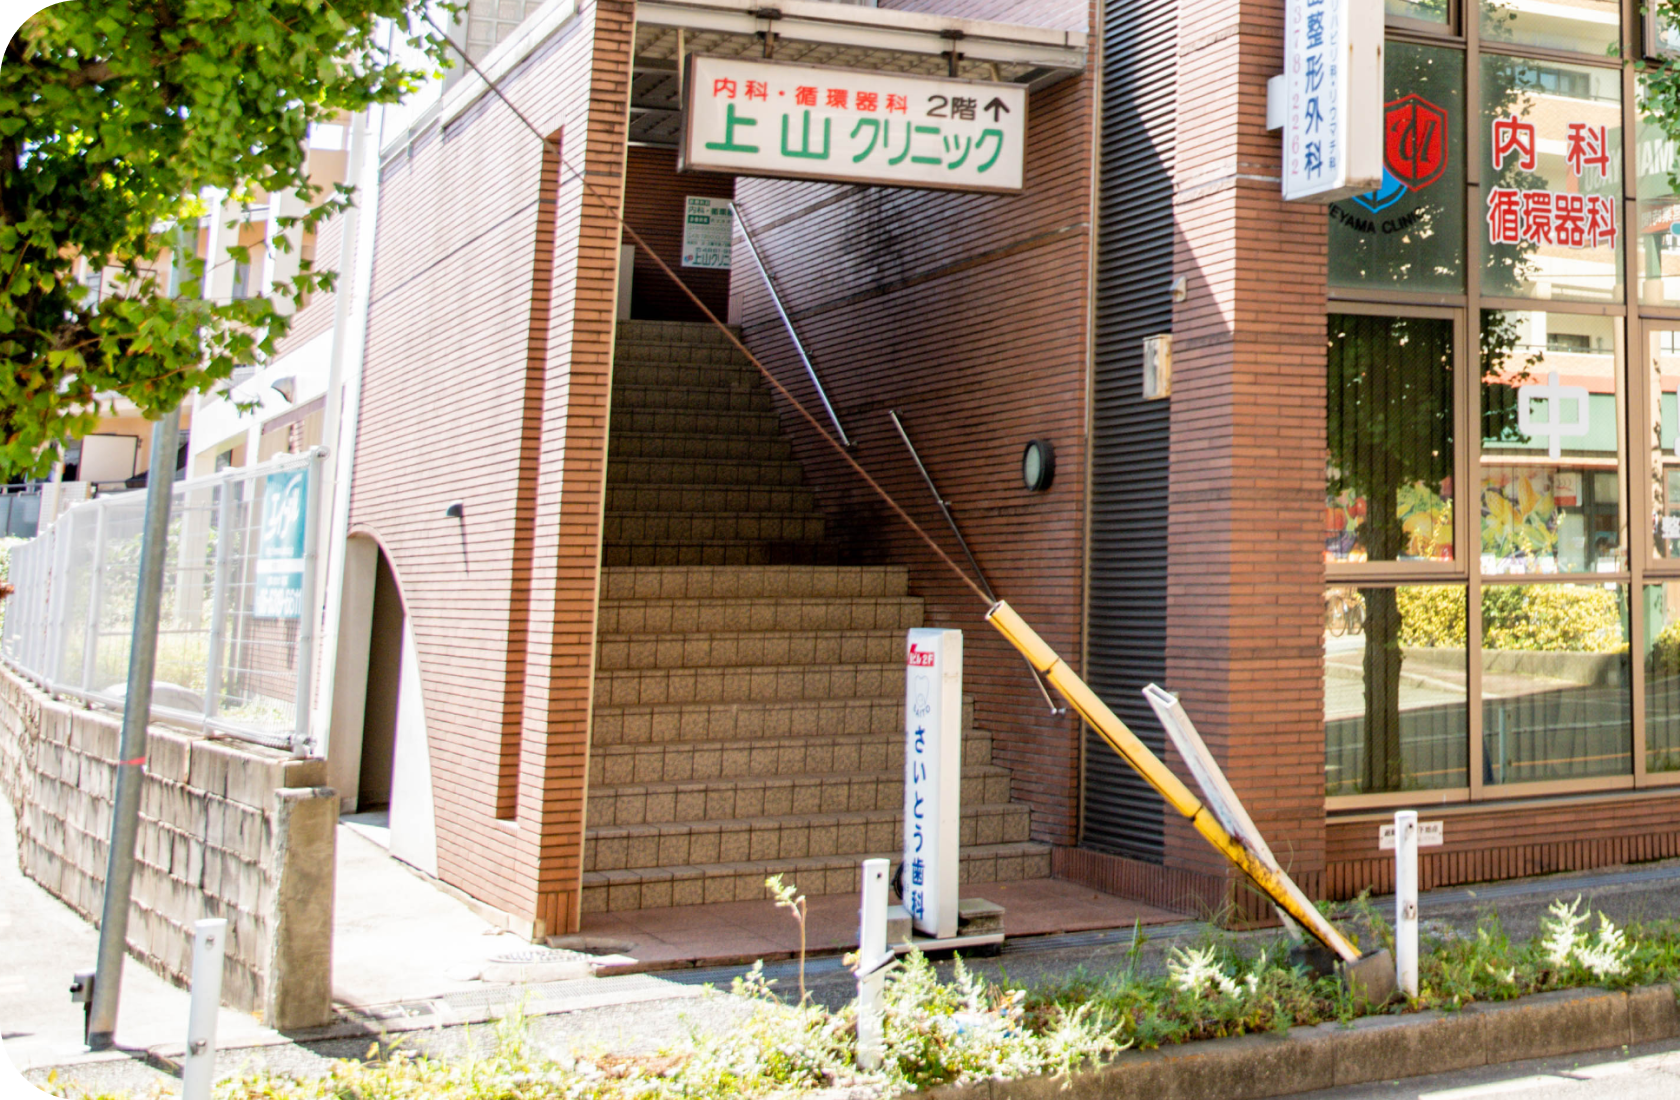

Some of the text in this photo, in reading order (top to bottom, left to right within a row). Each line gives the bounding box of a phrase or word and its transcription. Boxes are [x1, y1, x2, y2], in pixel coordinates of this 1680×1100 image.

[713, 77, 977, 121] 内科・循環器科 2階
[1303, 0, 1324, 180] 整形外科
[705, 103, 1004, 173] 上山クリニック
[1492, 114, 1610, 178] 内科
[1329, 203, 1376, 234] EYAMA
[1488, 188, 1617, 250] 循環器科
[911, 725, 926, 920] さいとう歯科
